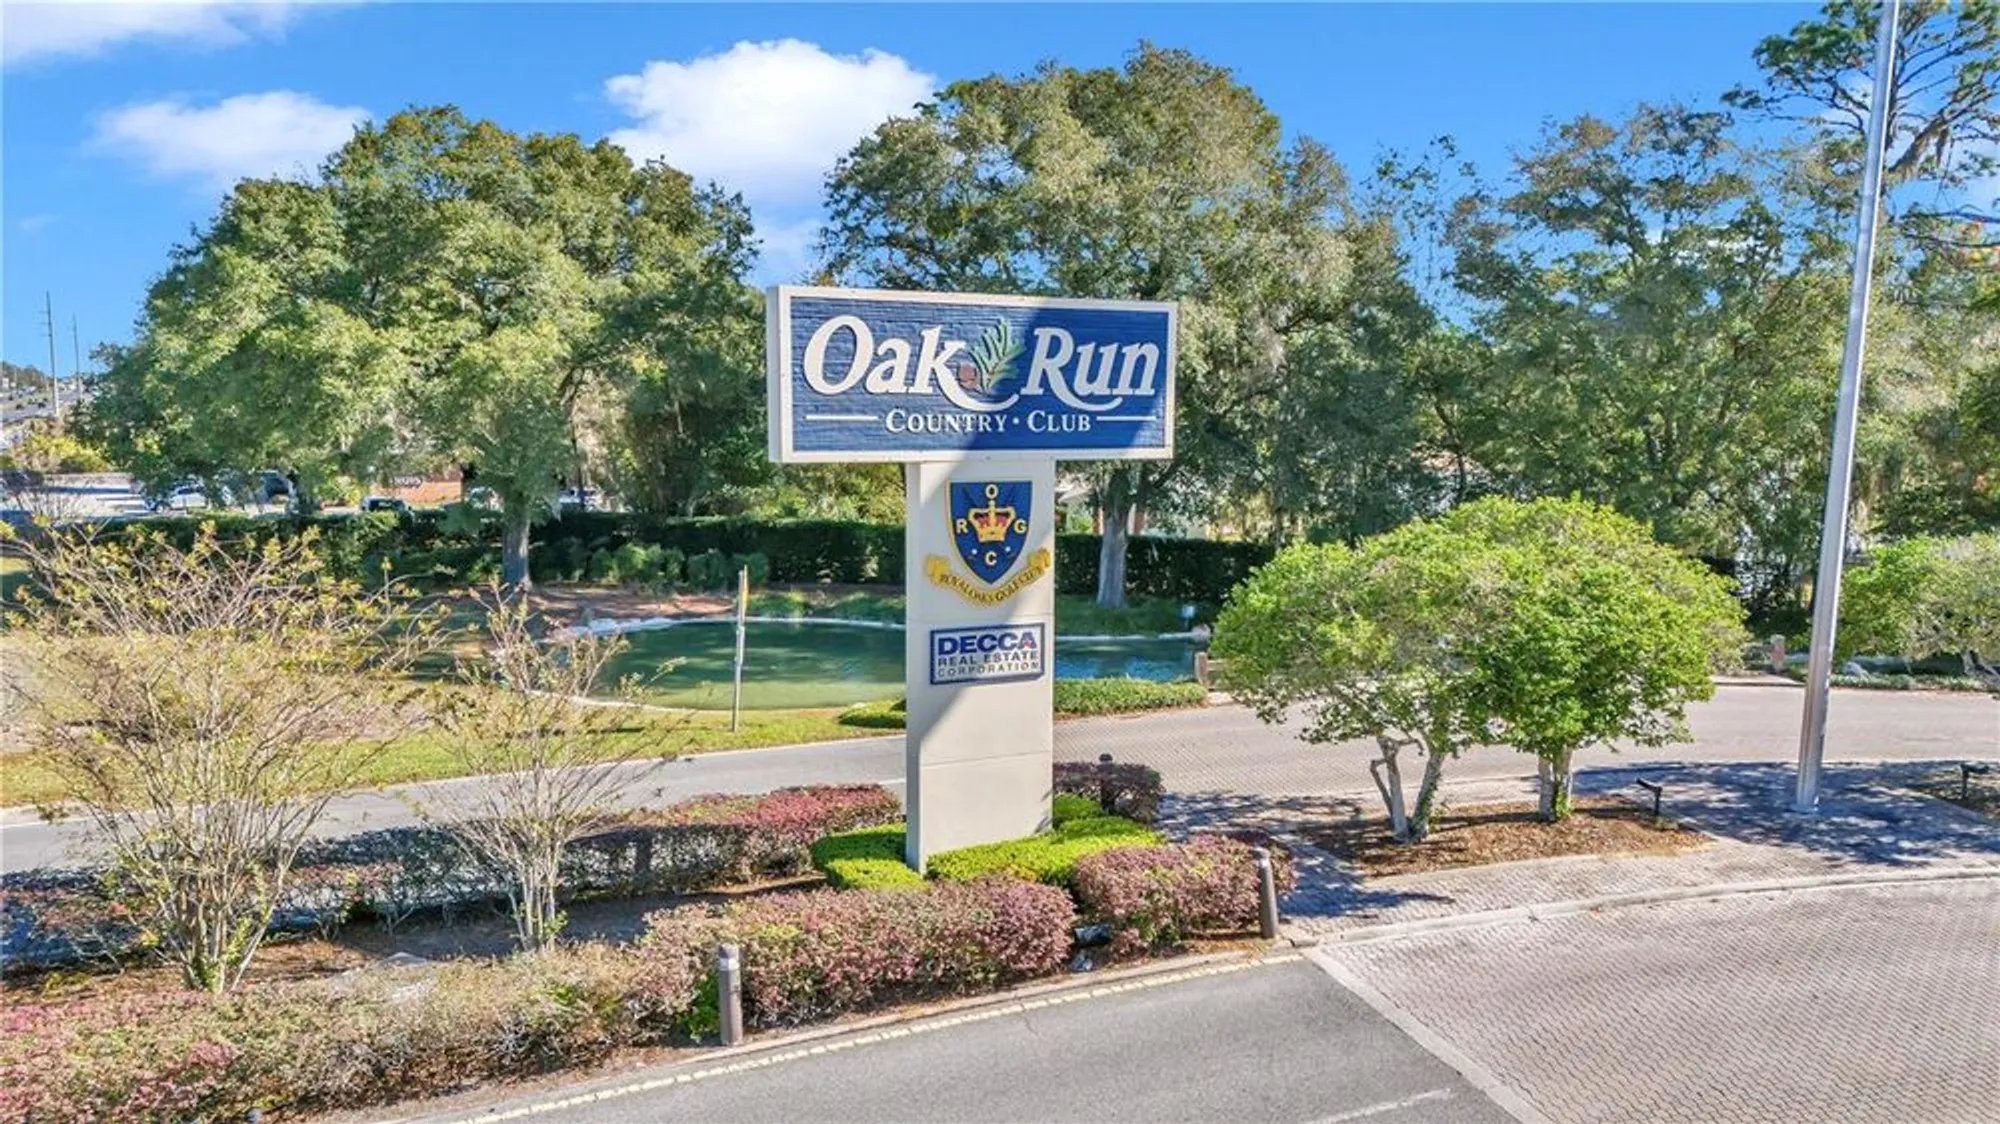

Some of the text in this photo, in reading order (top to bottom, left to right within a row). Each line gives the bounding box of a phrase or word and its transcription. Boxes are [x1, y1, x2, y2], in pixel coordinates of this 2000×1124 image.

[804, 315, 1160, 411] Oak Run
[886, 408, 1091, 433] COUNTRY CLUB
[985, 483, 999, 499] O
[956, 518, 1028, 534] R G
[985, 552, 998, 566] C
[938, 631, 1037, 656] DECCA
[938, 650, 1039, 667] REAL ESTATE
[938, 661, 1039, 678] CORPORATION
